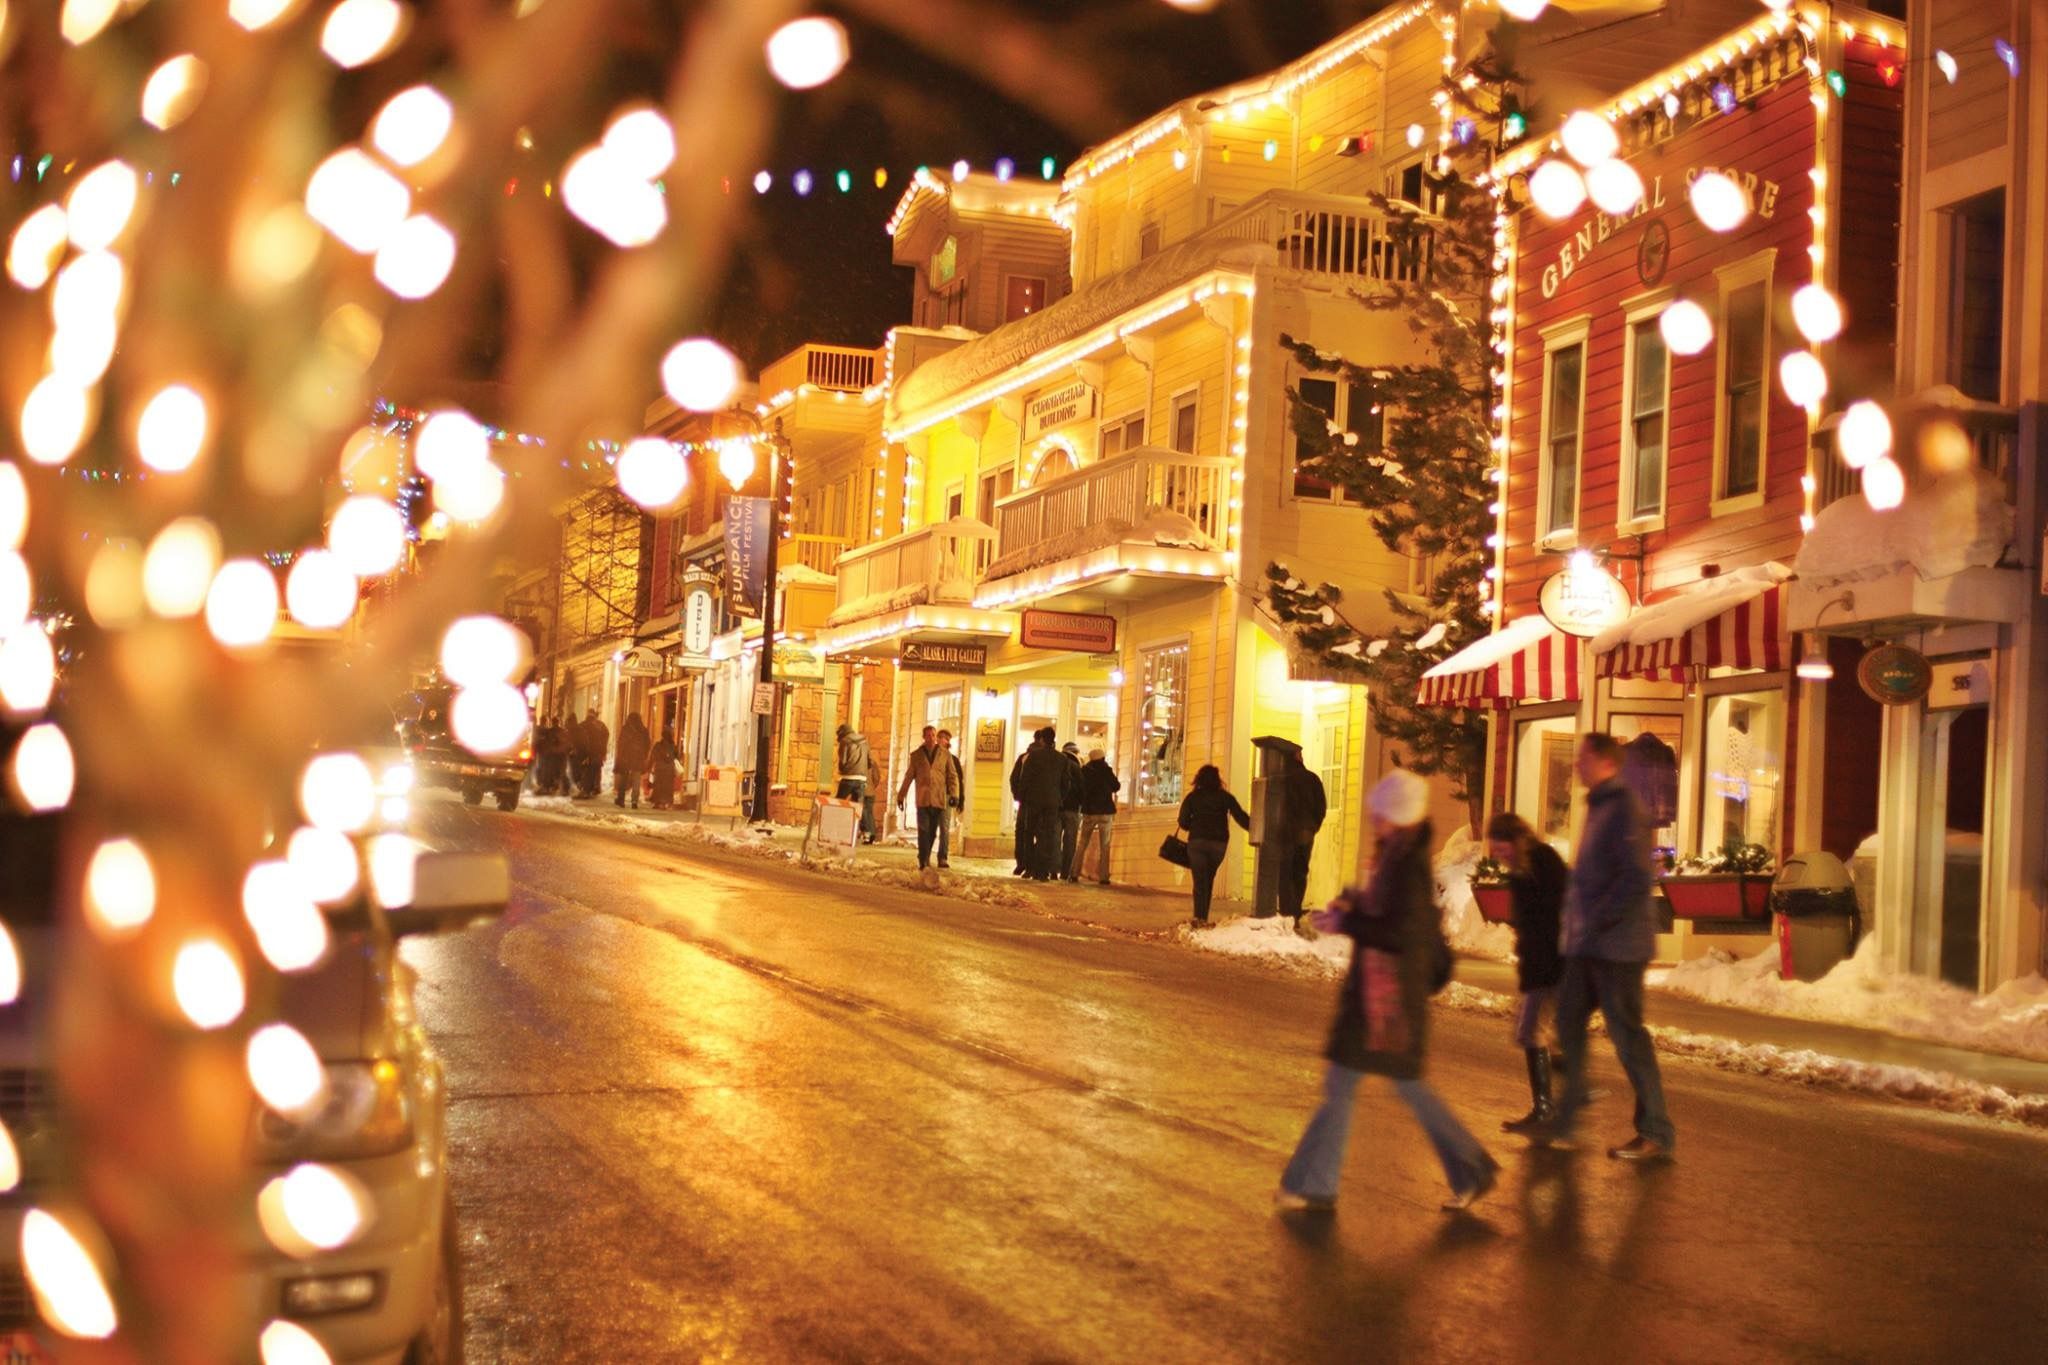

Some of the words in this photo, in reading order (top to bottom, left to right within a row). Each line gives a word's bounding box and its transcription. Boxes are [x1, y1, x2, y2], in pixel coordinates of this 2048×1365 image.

[1540, 174, 1667, 299] GENEAL
[1683, 165, 1779, 219] SRE
[1039, 403, 1077, 430] BUILDING
[729, 494, 743, 603] SUNDANCE
[742, 554, 751, 580] FILM
[695, 594, 704, 649] DELI
[922, 645, 945, 661] ALASKA
[946, 647, 958, 662] FUR
[958, 648, 985, 665] GALLERY
